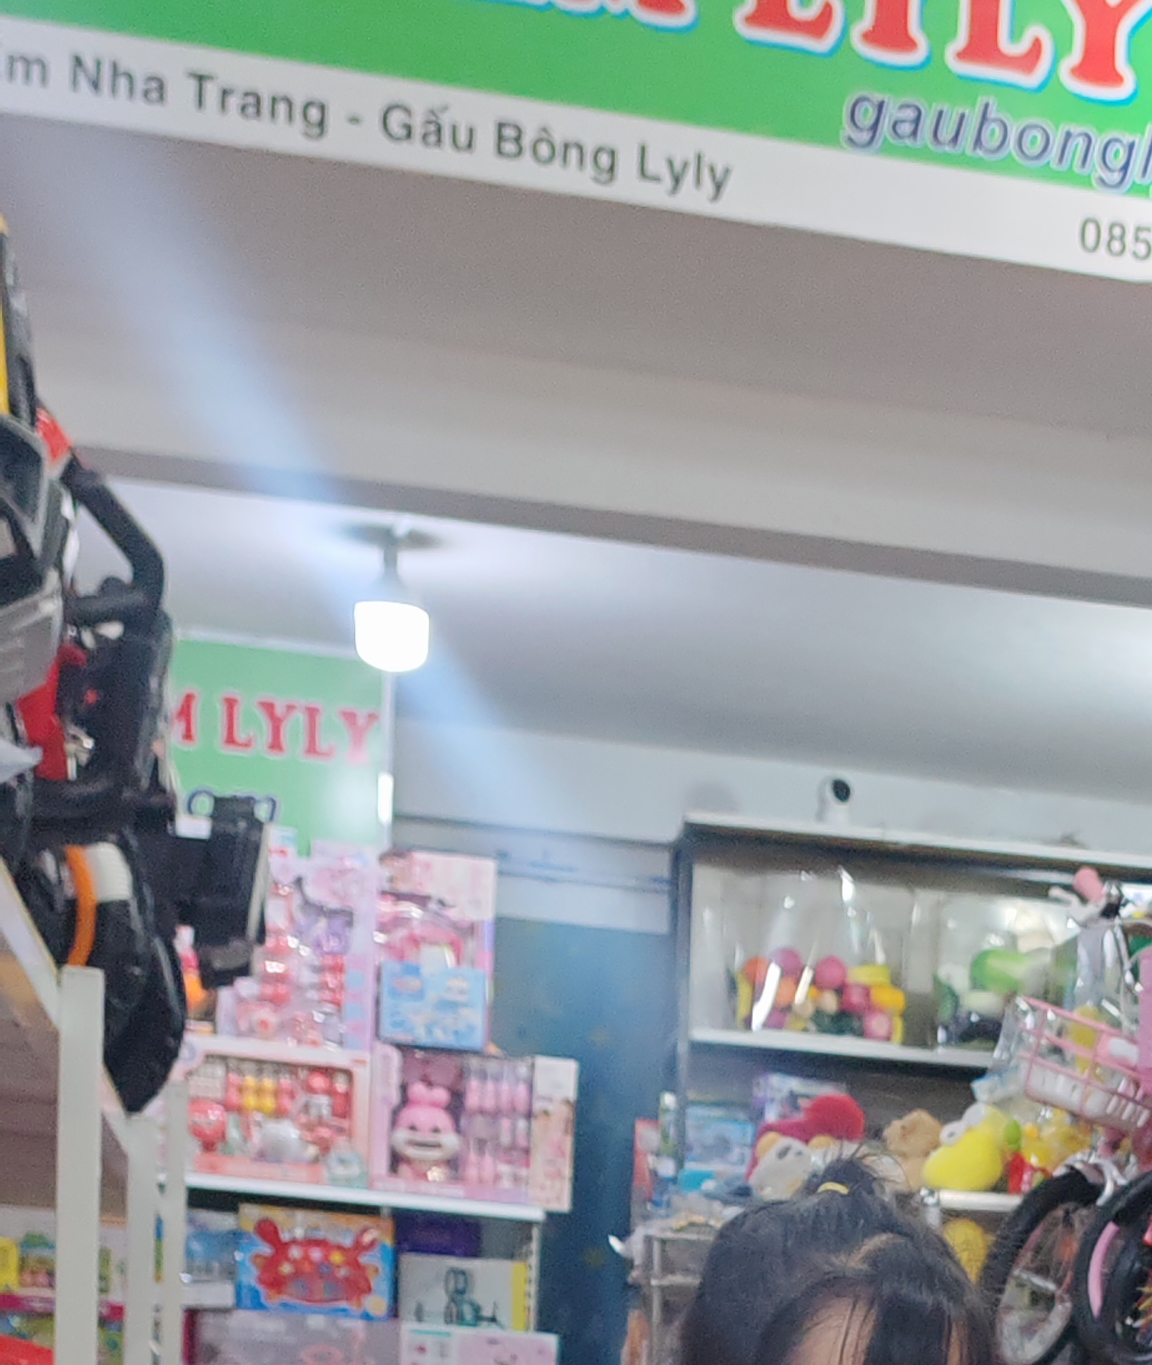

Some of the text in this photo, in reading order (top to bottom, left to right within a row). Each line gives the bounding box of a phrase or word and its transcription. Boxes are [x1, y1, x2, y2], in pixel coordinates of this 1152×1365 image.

[70, 53, 166, 106] Nha
[187, 70, 329, 141] Trang
[380, 101, 477, 153] Gấu
[494, 120, 619, 186] Bông
[637, 140, 733, 203] Lyly
[1078, 216, 1152, 262] 085
[221, 695, 381, 763] LYLY
